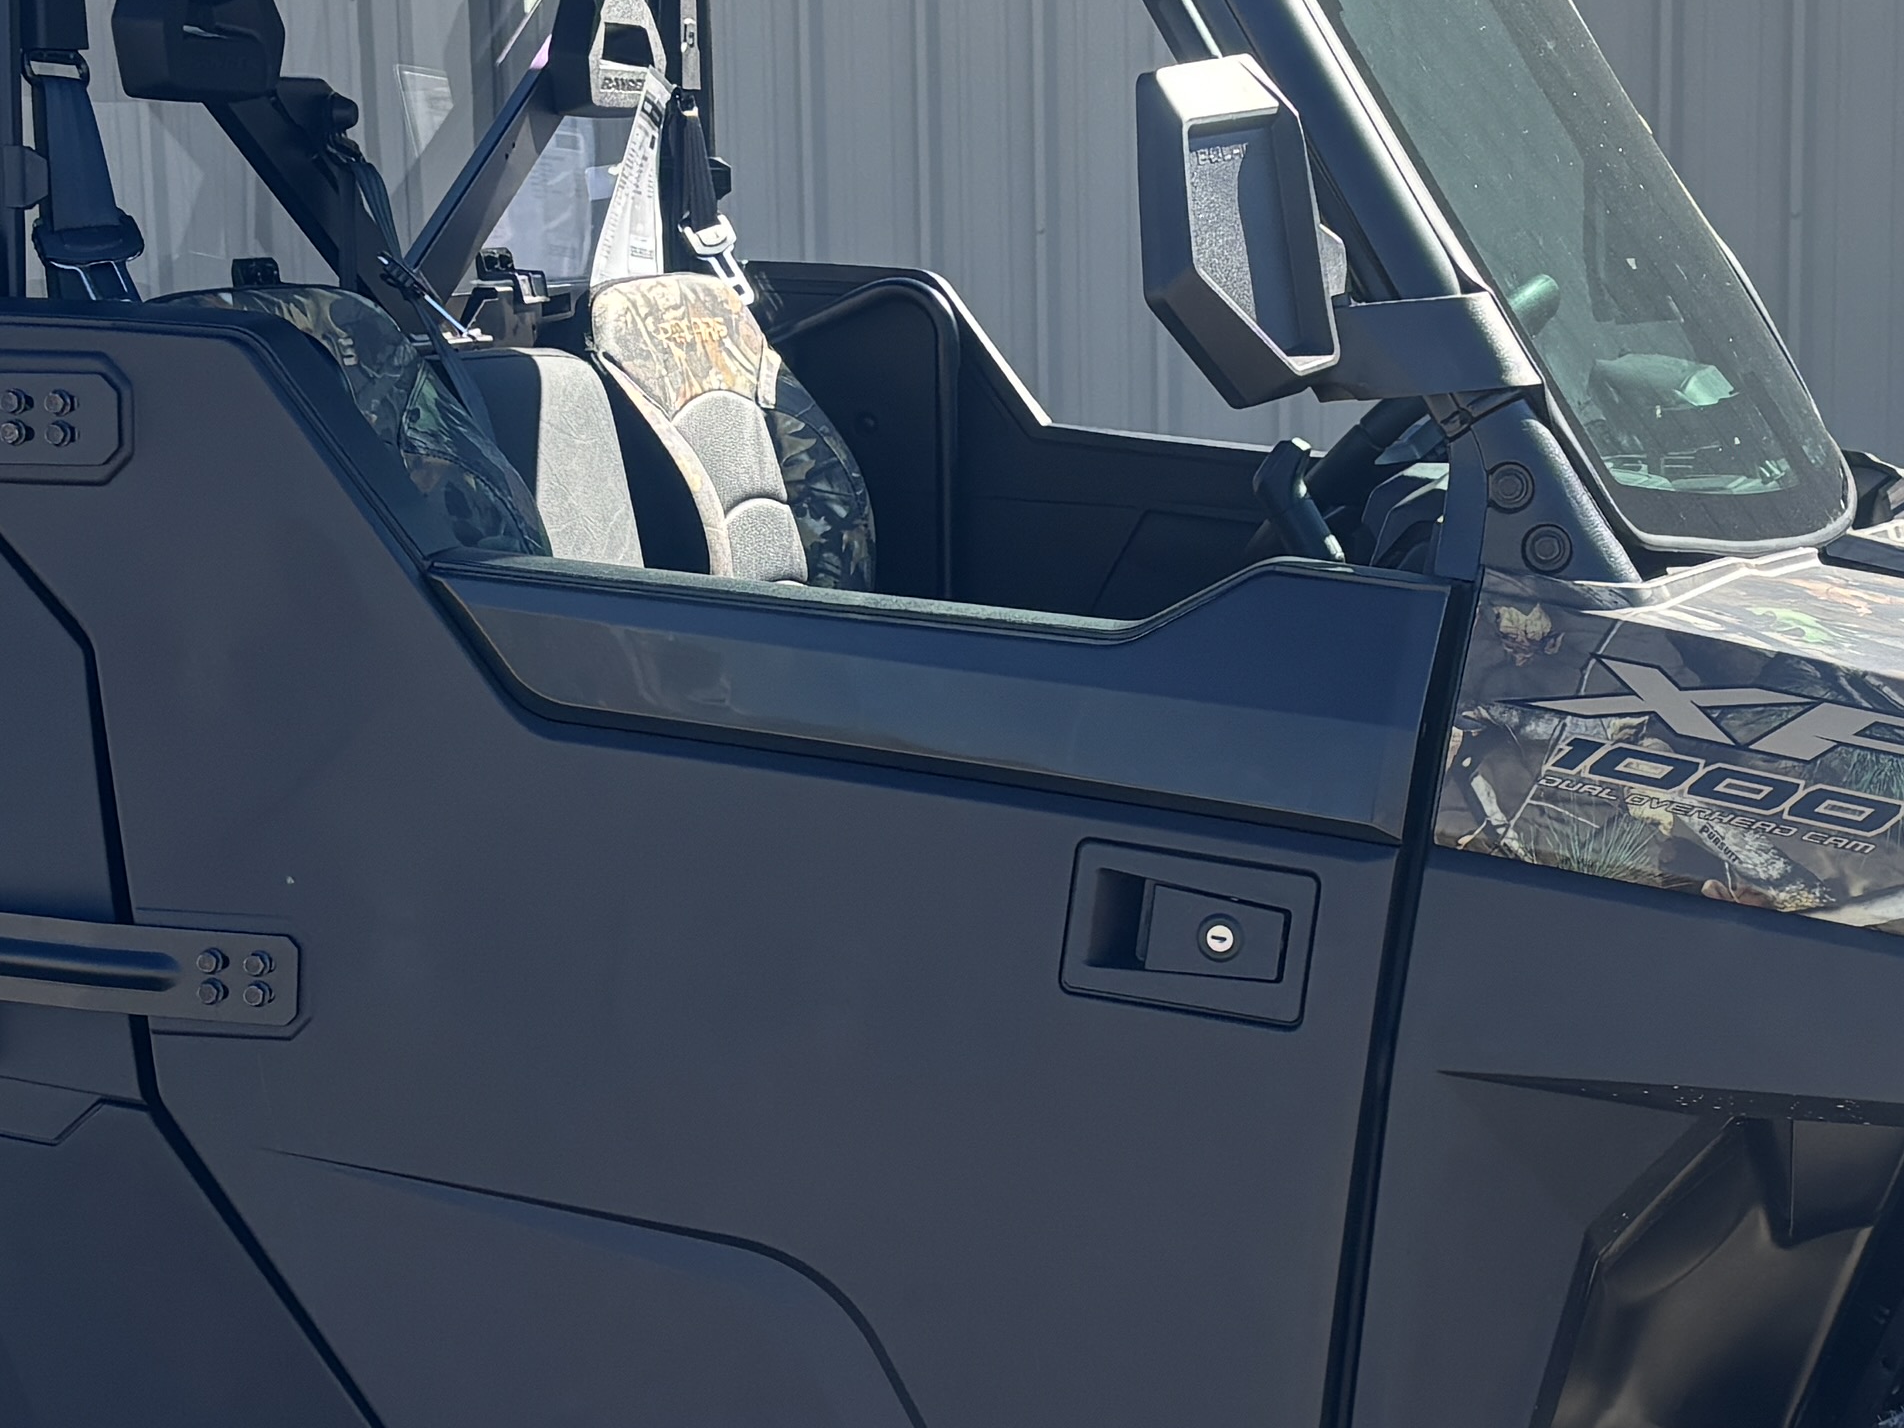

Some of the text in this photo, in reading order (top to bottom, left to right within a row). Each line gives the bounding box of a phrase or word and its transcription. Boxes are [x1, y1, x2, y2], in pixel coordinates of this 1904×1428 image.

[1537, 775, 1878, 855] DUAL OVERHEAD CAM
[1698, 824, 1742, 865] PURSUIT
